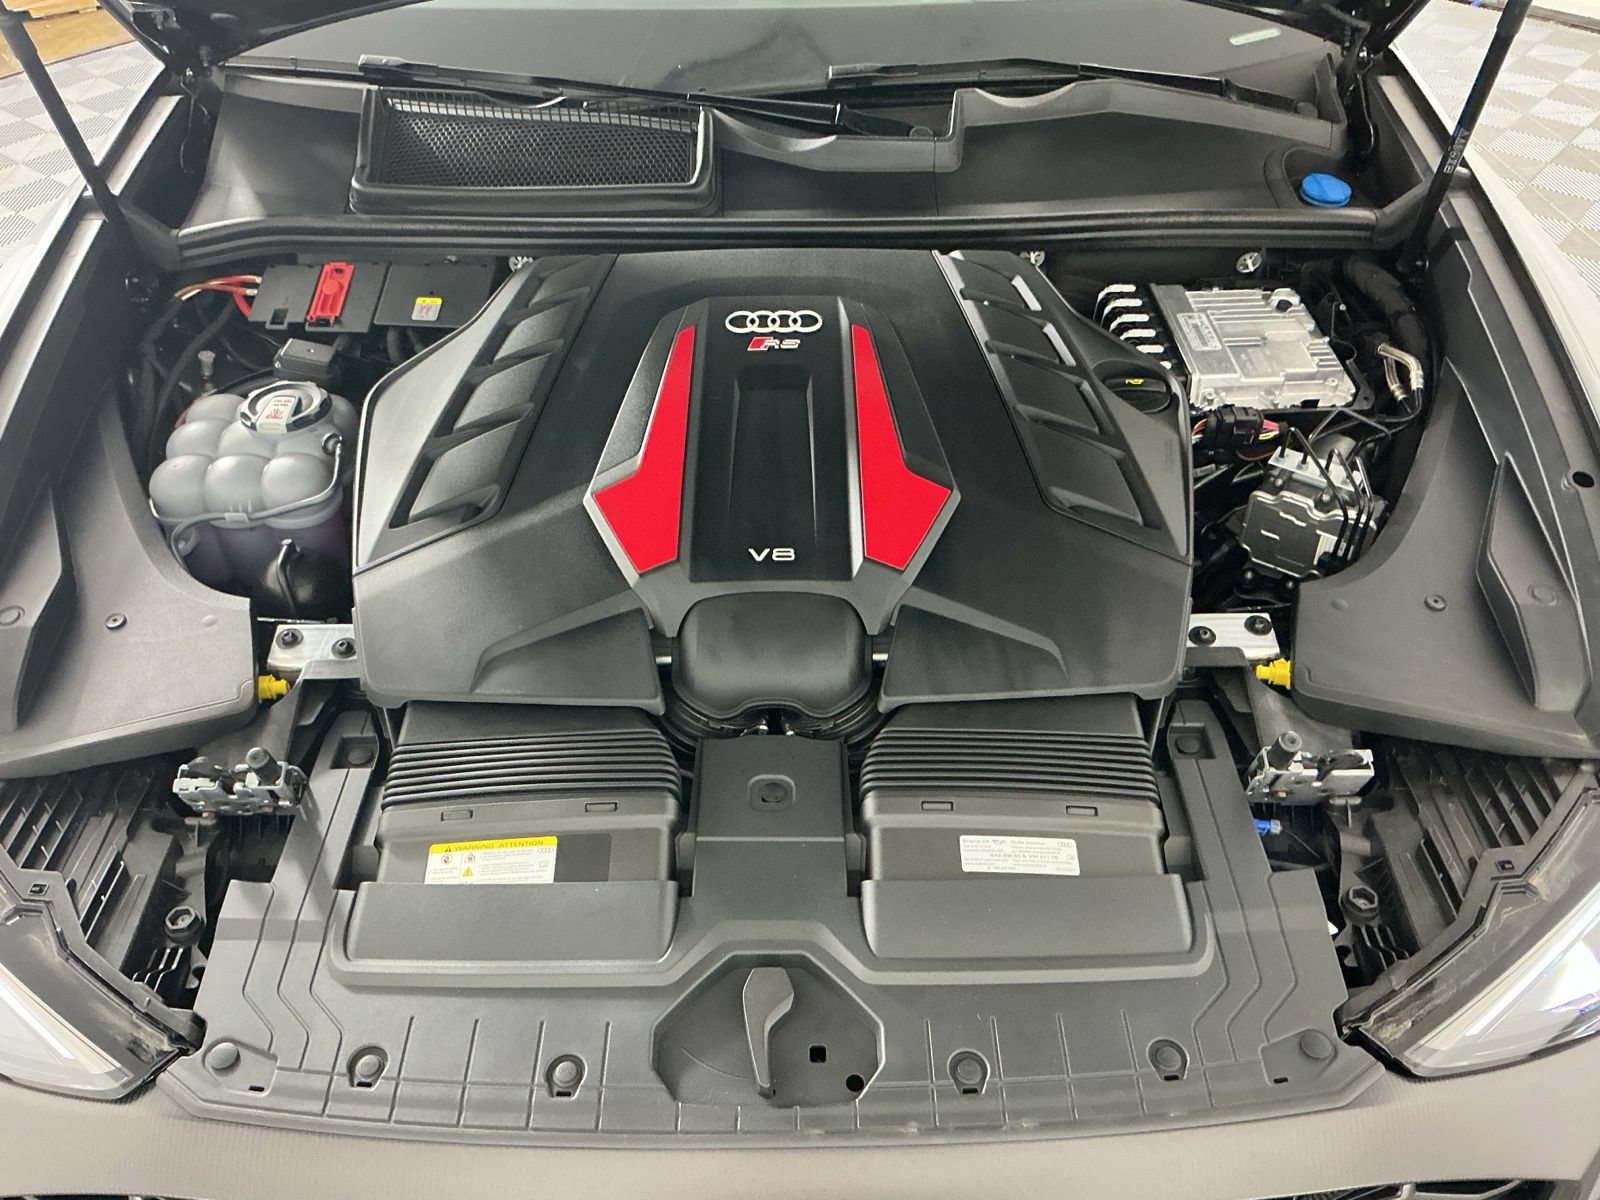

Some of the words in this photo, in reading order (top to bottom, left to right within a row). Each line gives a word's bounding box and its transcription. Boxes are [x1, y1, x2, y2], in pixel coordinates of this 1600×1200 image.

[748, 336, 801, 351] RS
[747, 547, 796, 562] V8
[454, 843, 494, 851] WARNING
[499, 840, 544, 848] ATTENTION
